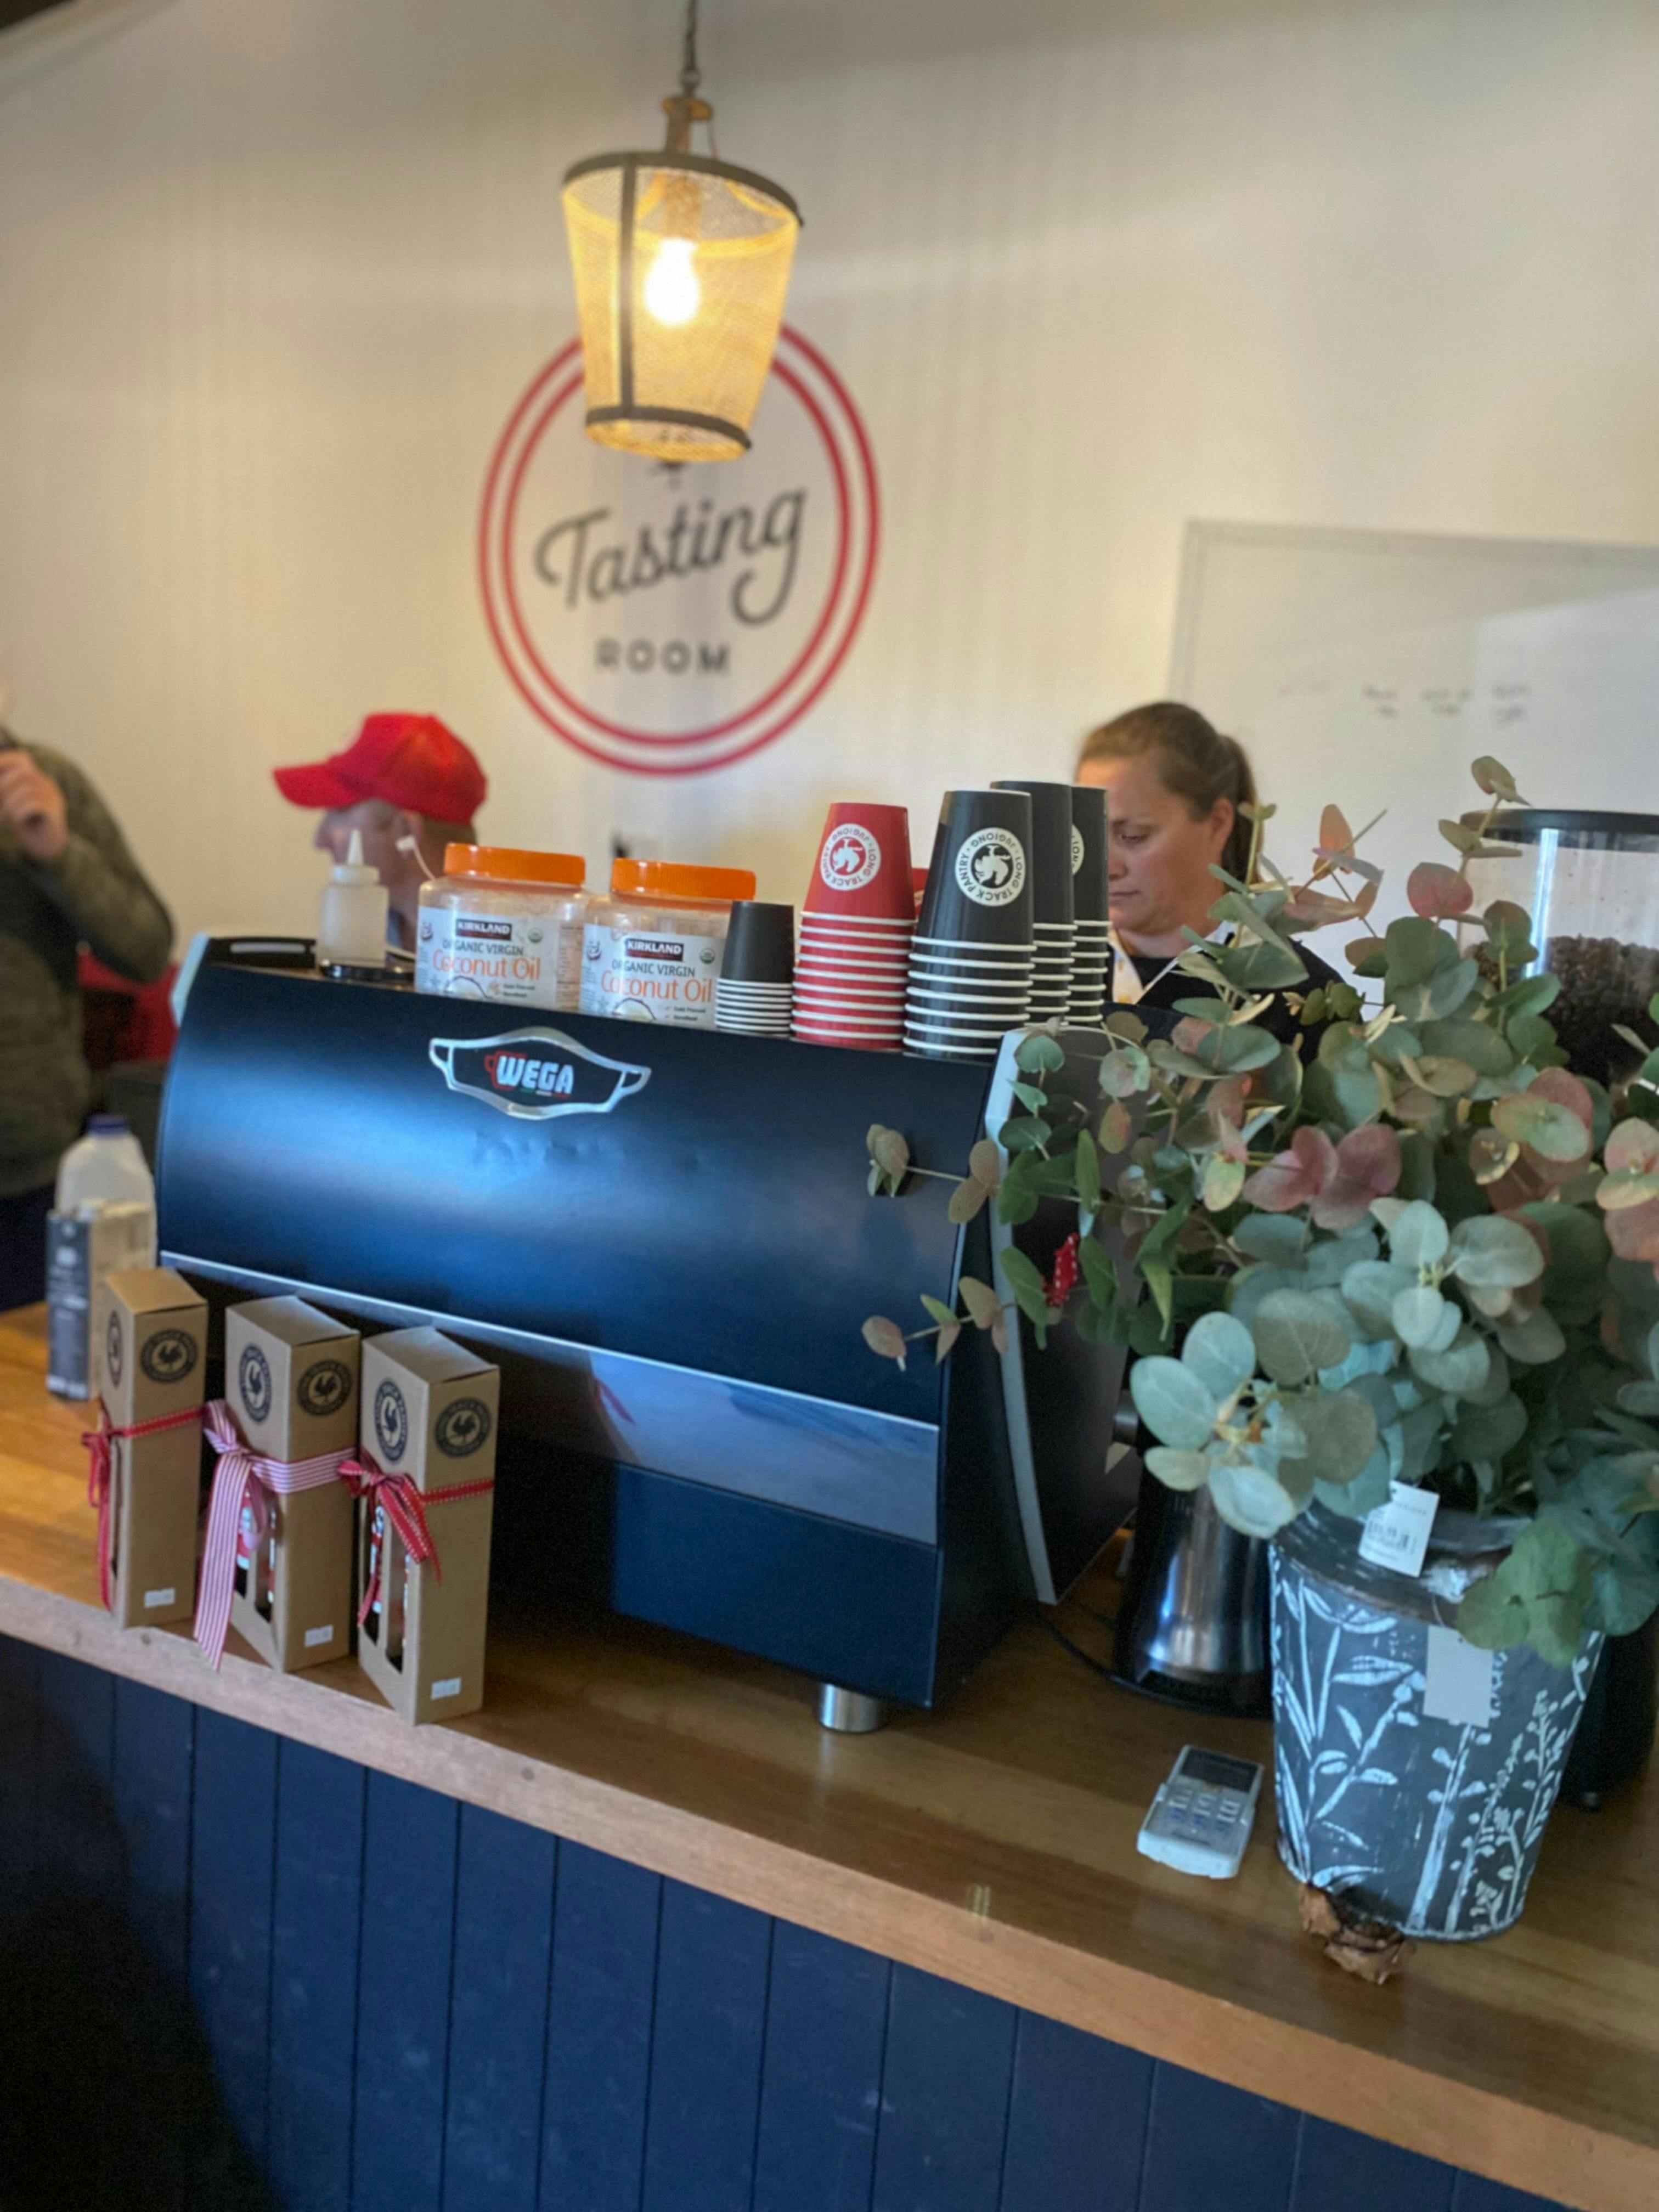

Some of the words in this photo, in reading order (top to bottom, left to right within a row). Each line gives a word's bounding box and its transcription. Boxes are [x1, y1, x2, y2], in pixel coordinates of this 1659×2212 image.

[534, 488, 805, 627] Tasting
[596, 636, 730, 675] ROOM
[970, 832, 1017, 848] JUGIONG
[862, 848, 877, 876] LONG
[958, 853, 977, 893] PANTRY
[1011, 856, 1023, 889] LONG
[975, 887, 1014, 901] TRACK
[458, 921, 510, 934] KIRKLAND
[487, 944, 524, 956] VIRGIN
[627, 939, 683, 955] KIRKLAND
[432, 949, 509, 978] Coconut
[512, 956, 541, 981] Oil
[658, 964, 696, 978] VIRGIN
[601, 970, 679, 1001] Coconut
[684, 978, 713, 1003] Oil
[496, 1055, 575, 1095] WEGA
